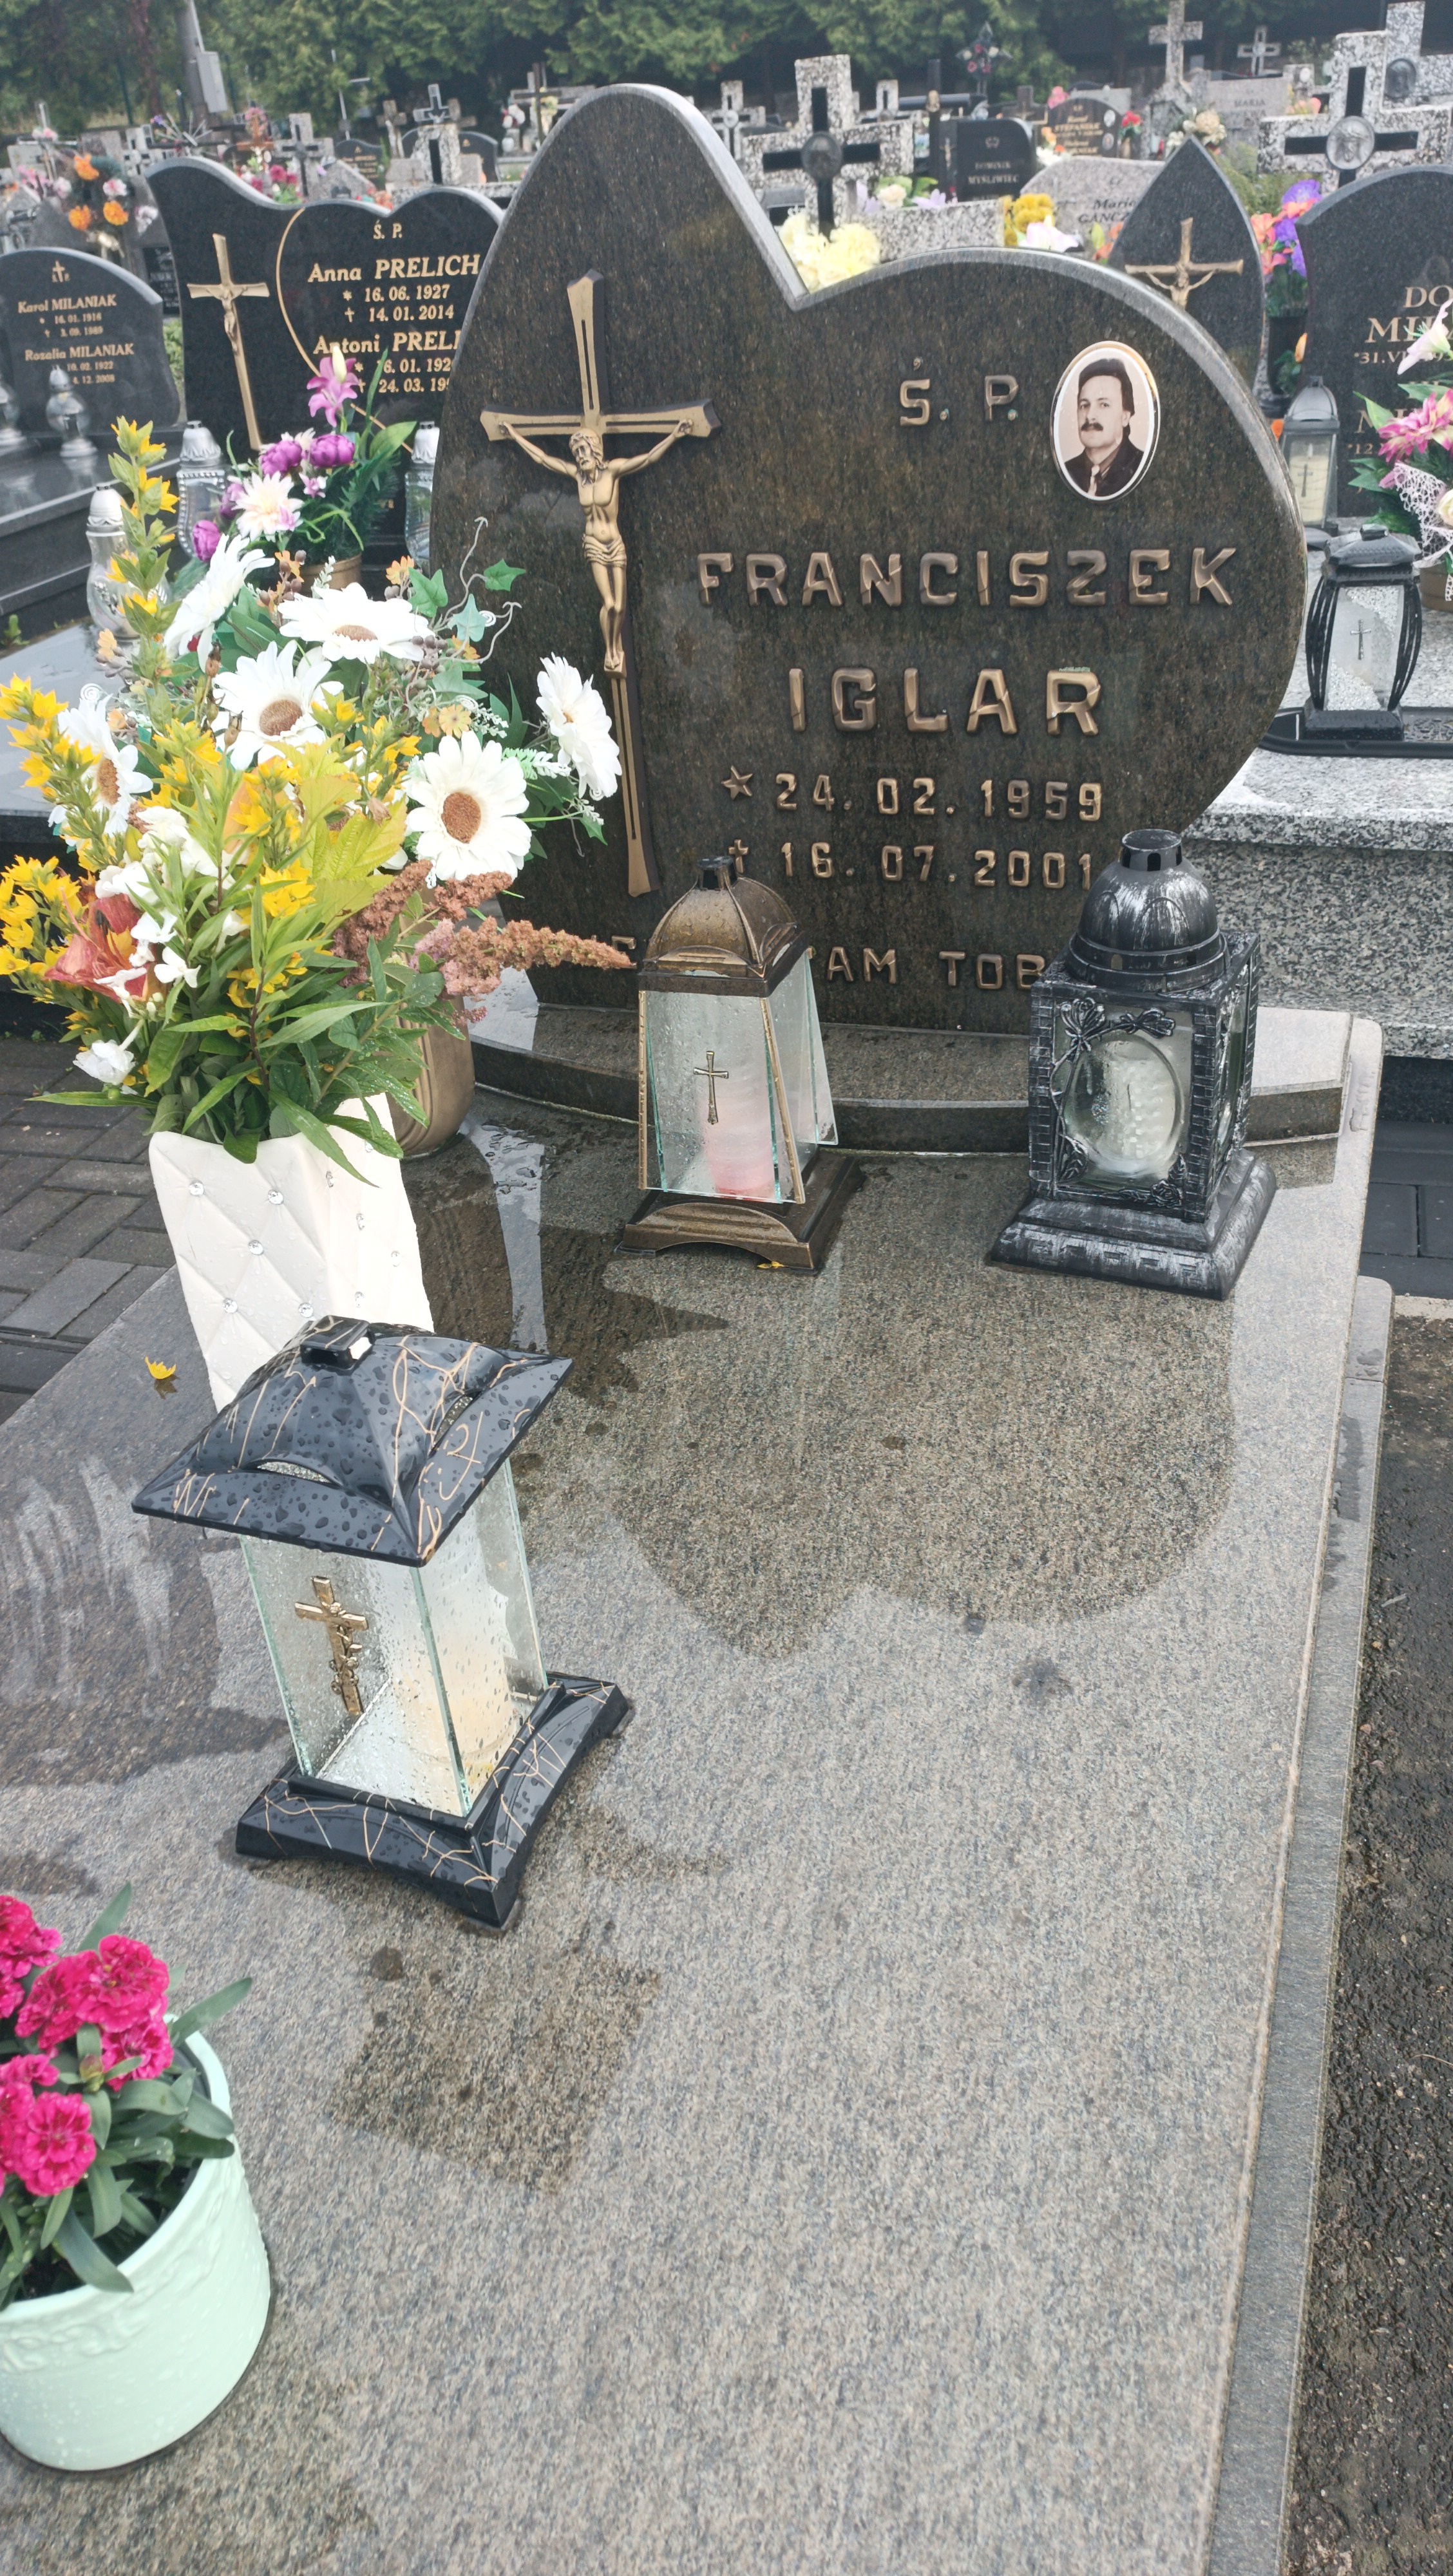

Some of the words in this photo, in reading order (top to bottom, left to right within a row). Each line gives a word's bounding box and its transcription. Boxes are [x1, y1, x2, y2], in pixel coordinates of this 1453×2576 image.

[308, 263, 362, 283] Anna
[374, 254, 480, 279] PRELICH
[17, 299, 49, 314] Karol
[52, 294, 117, 312] MILANIAK
[365, 287, 385, 303] 16.
[388, 285, 410, 301] 06.
[416, 283, 450, 300] 1927
[369, 307, 388, 322] 14.
[393, 306, 415, 321] 01.
[419, 304, 455, 321] 2014
[24, 348, 66, 361] Rozalia
[70, 343, 135, 359] MILANIAK
[313, 334, 380, 354] Antoni
[392, 329, 462, 352] PRELI
[399, 358, 421, 373] 01.
[426, 357, 453, 372] 192
[379, 378, 399, 393] 24.
[403, 377, 424, 393] 03.
[430, 377, 450, 392] 19
[899, 356, 949, 427] Ś.
[983, 374, 1019, 422] P.
[696, 547, 1237, 608] FRANCISZEK
[788, 667, 1102, 737] IGLAR
[775, 773, 852, 811] 24.
[877, 777, 955, 816] 02.
[980, 779, 1102, 822] 1959
[781, 841, 855, 879] 16.
[880, 844, 956, 883] 07.
[973, 849, 1092, 891] 2001
[938, 951, 1046, 990] TOB
